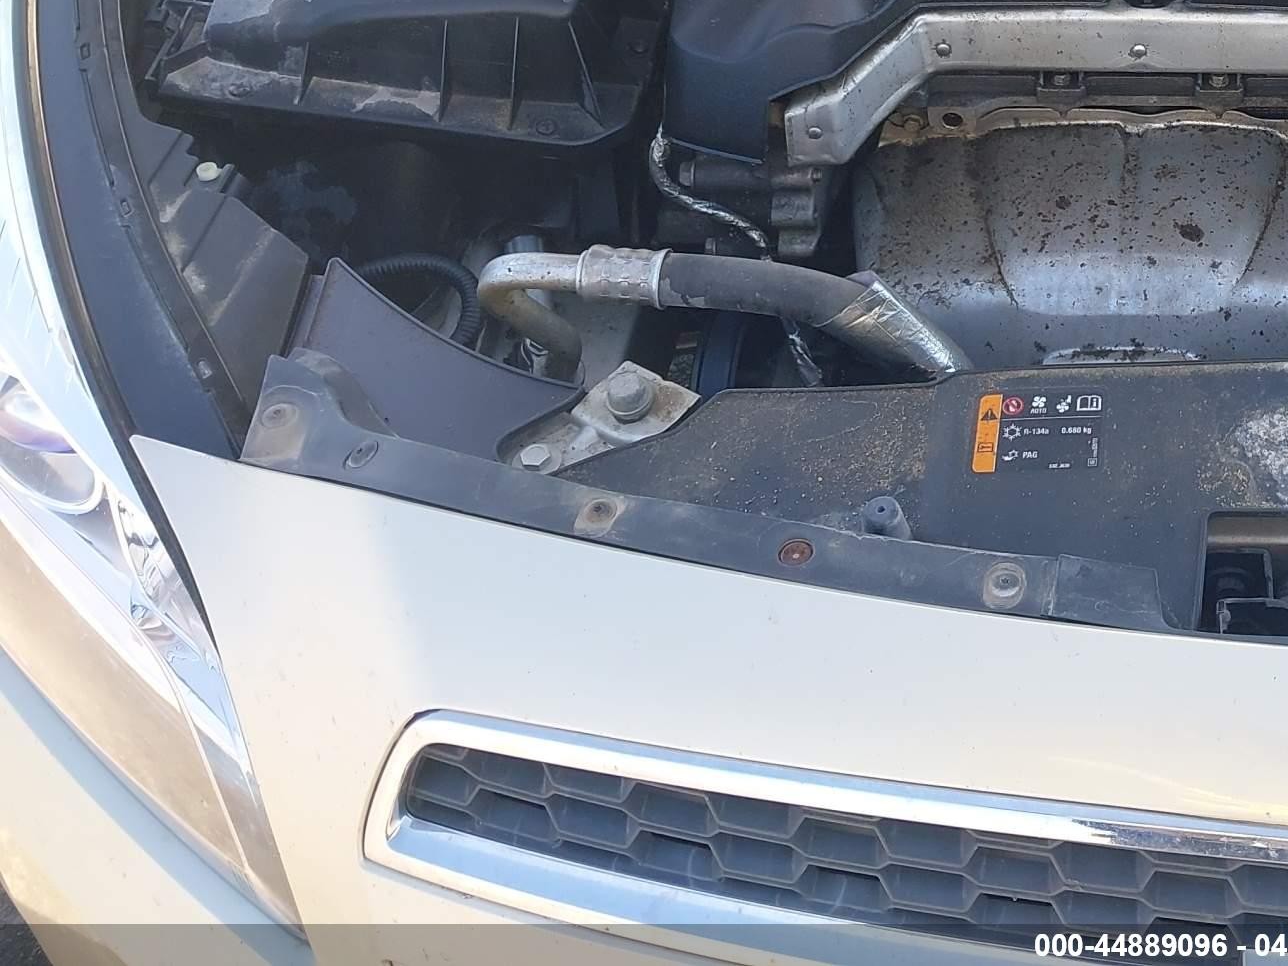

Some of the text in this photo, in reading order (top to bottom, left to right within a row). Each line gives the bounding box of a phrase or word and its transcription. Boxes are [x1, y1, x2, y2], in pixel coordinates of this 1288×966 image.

[1024, 427, 1049, 435] R-134a
[1083, 426, 1092, 435] kg
[1022, 451, 1038, 459] PAG
